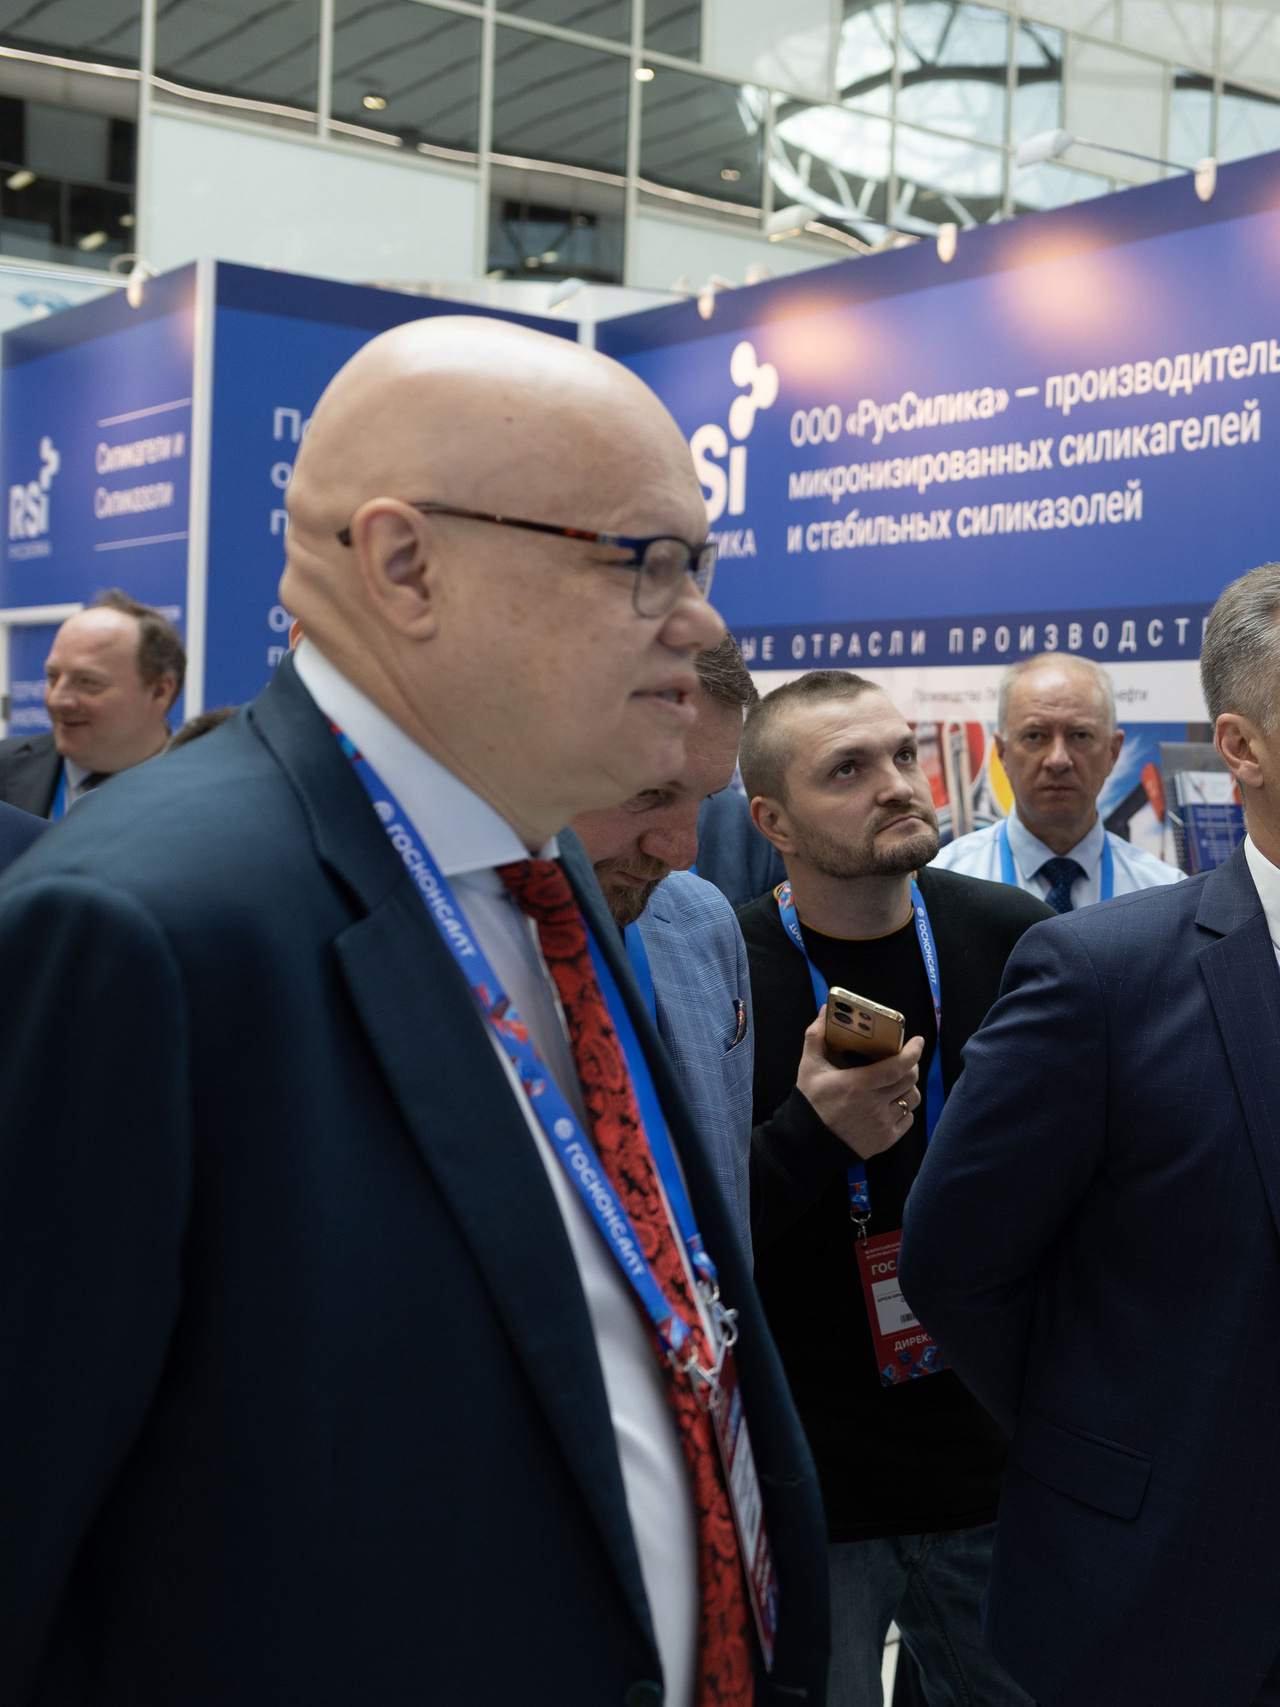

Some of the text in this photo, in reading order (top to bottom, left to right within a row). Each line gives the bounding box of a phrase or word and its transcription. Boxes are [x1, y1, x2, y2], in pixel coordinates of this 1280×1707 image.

[788, 398, 1262, 505] микронизированных силикагелей
[790, 404, 842, 448] ООО
[846, 386, 1010, 445] «РусСилика»
[787, 524, 803, 554] и
[806, 508, 952, 552] стабильных
[956, 478, 1144, 538] силиказолей
[792, 630, 926, 660] ОТРАСЛИ
[386, 825, 477, 958] ГОСКОНСАЛТ
[918, 919, 937, 984] ГОСКОНСАЛТ
[565, 1143, 645, 1277] ГОСКОНСАЛТ
[894, 1334, 932, 1352] ДИРЕК
